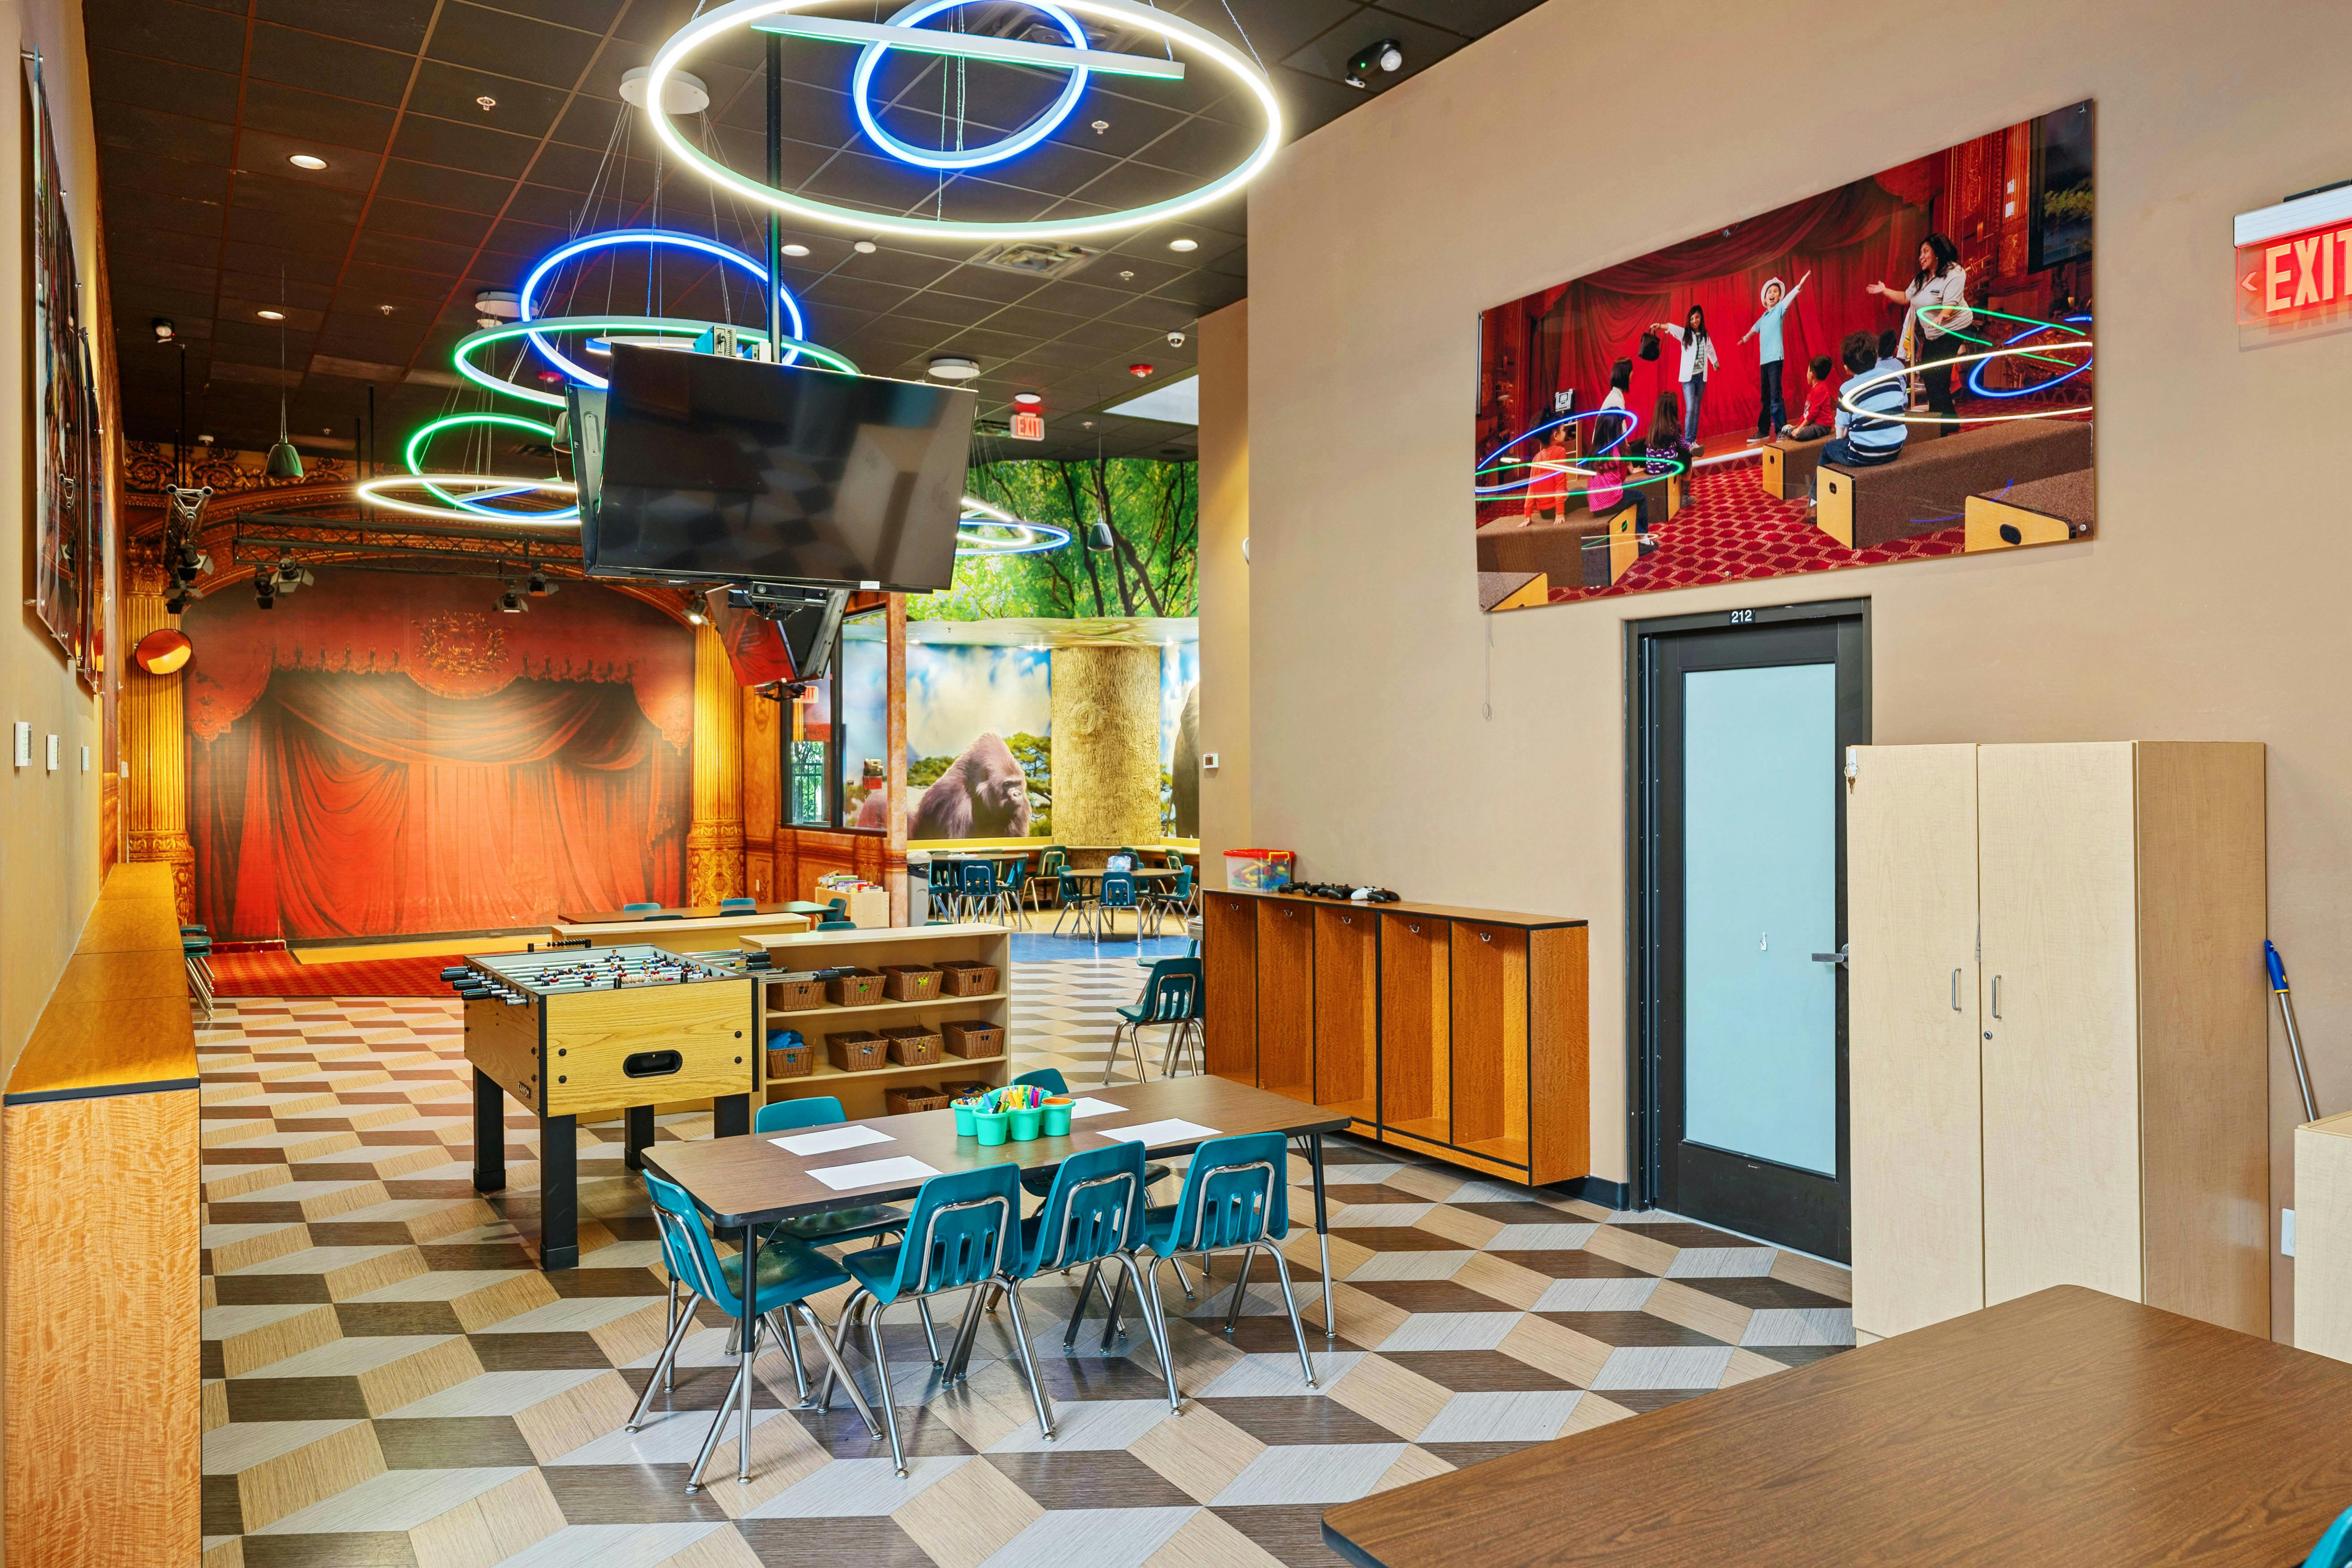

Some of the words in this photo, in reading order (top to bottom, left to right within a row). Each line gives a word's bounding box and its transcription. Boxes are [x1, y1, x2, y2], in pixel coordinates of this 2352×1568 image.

[2266, 228, 2352, 312] EXIT
[1017, 416, 1040, 437] EXIT
[1732, 609, 1752, 623] 212
